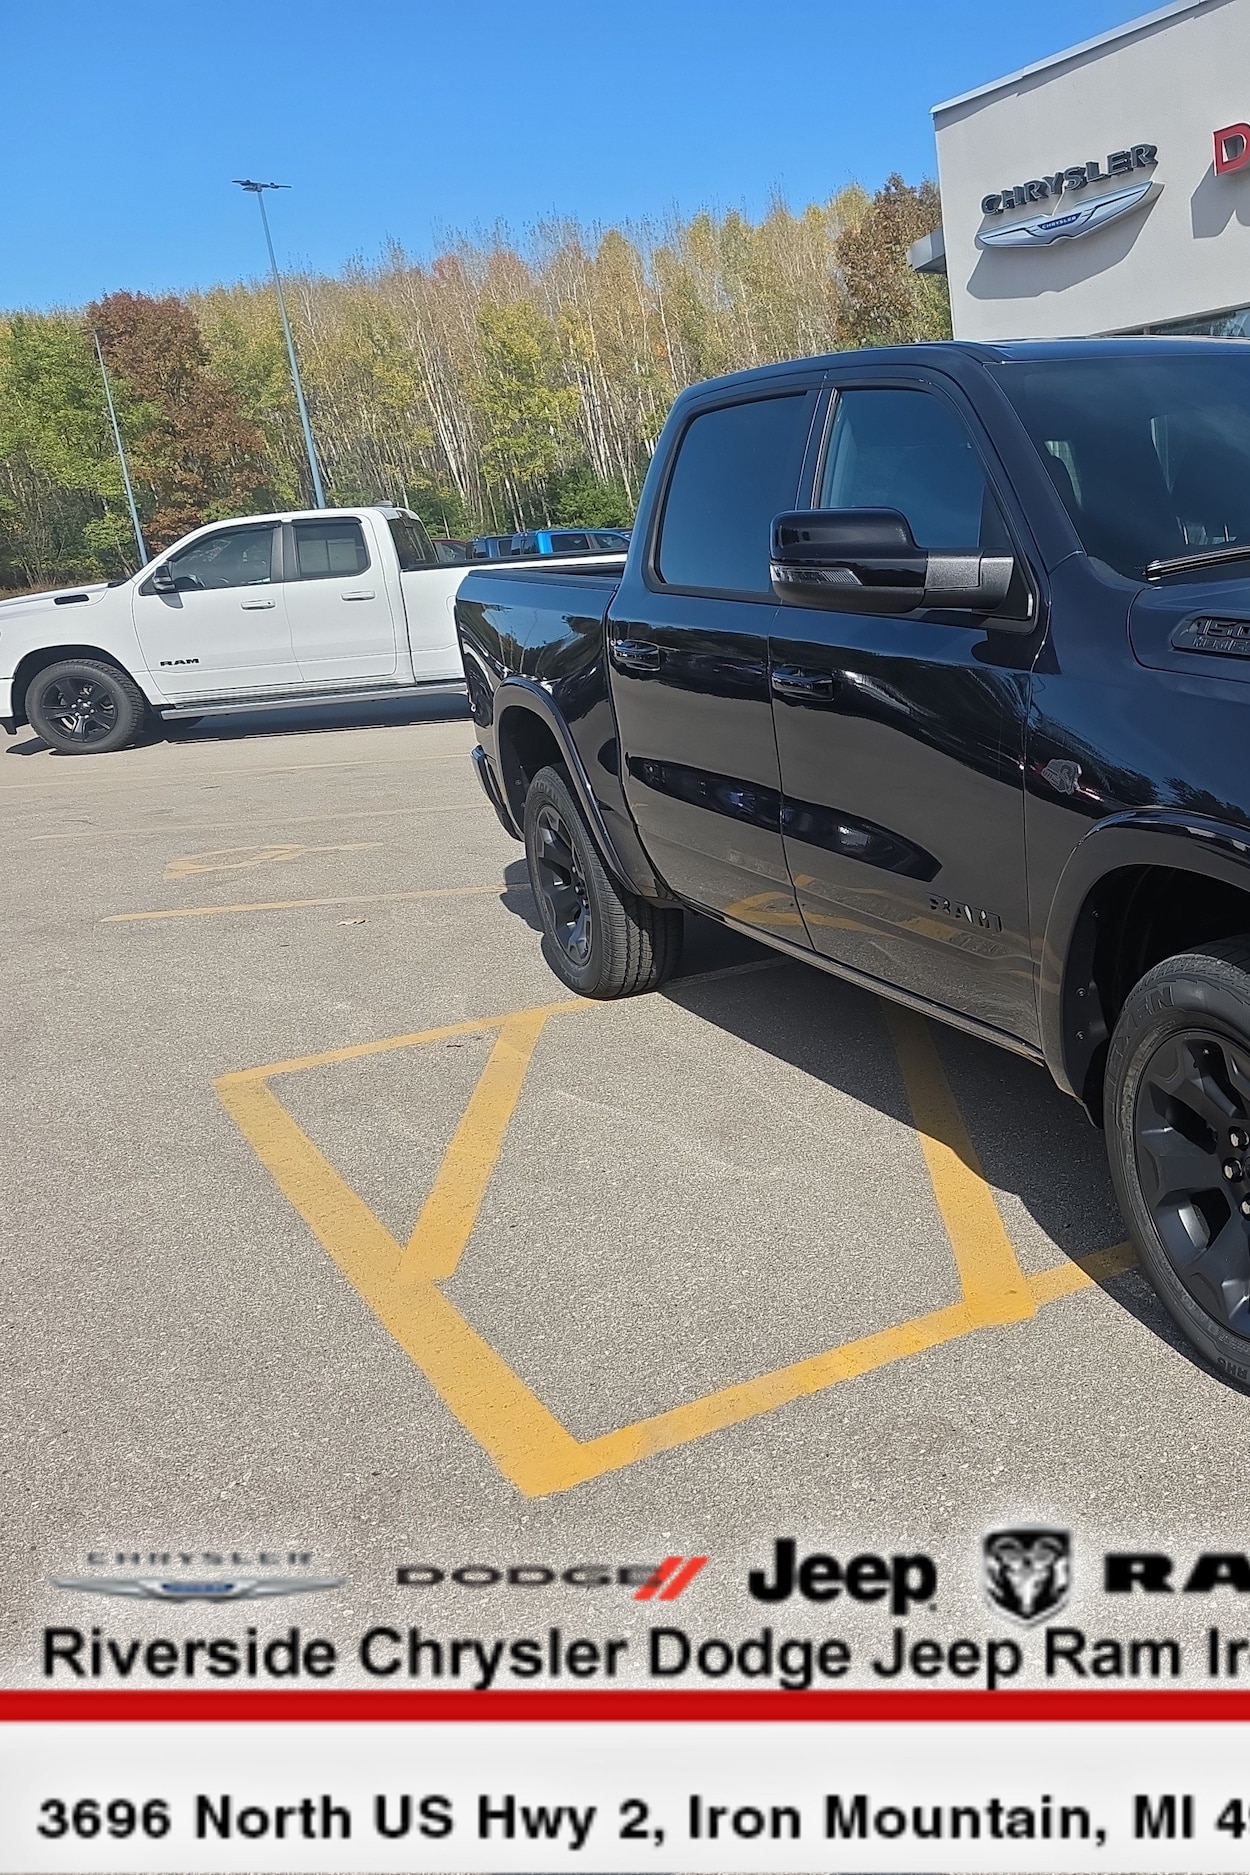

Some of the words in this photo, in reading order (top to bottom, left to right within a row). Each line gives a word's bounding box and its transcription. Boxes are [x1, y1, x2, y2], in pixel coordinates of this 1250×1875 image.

[982, 143, 1158, 215] CHRYSLER
[160, 658, 200, 667] RAM
[925, 891, 1003, 933] RAM
